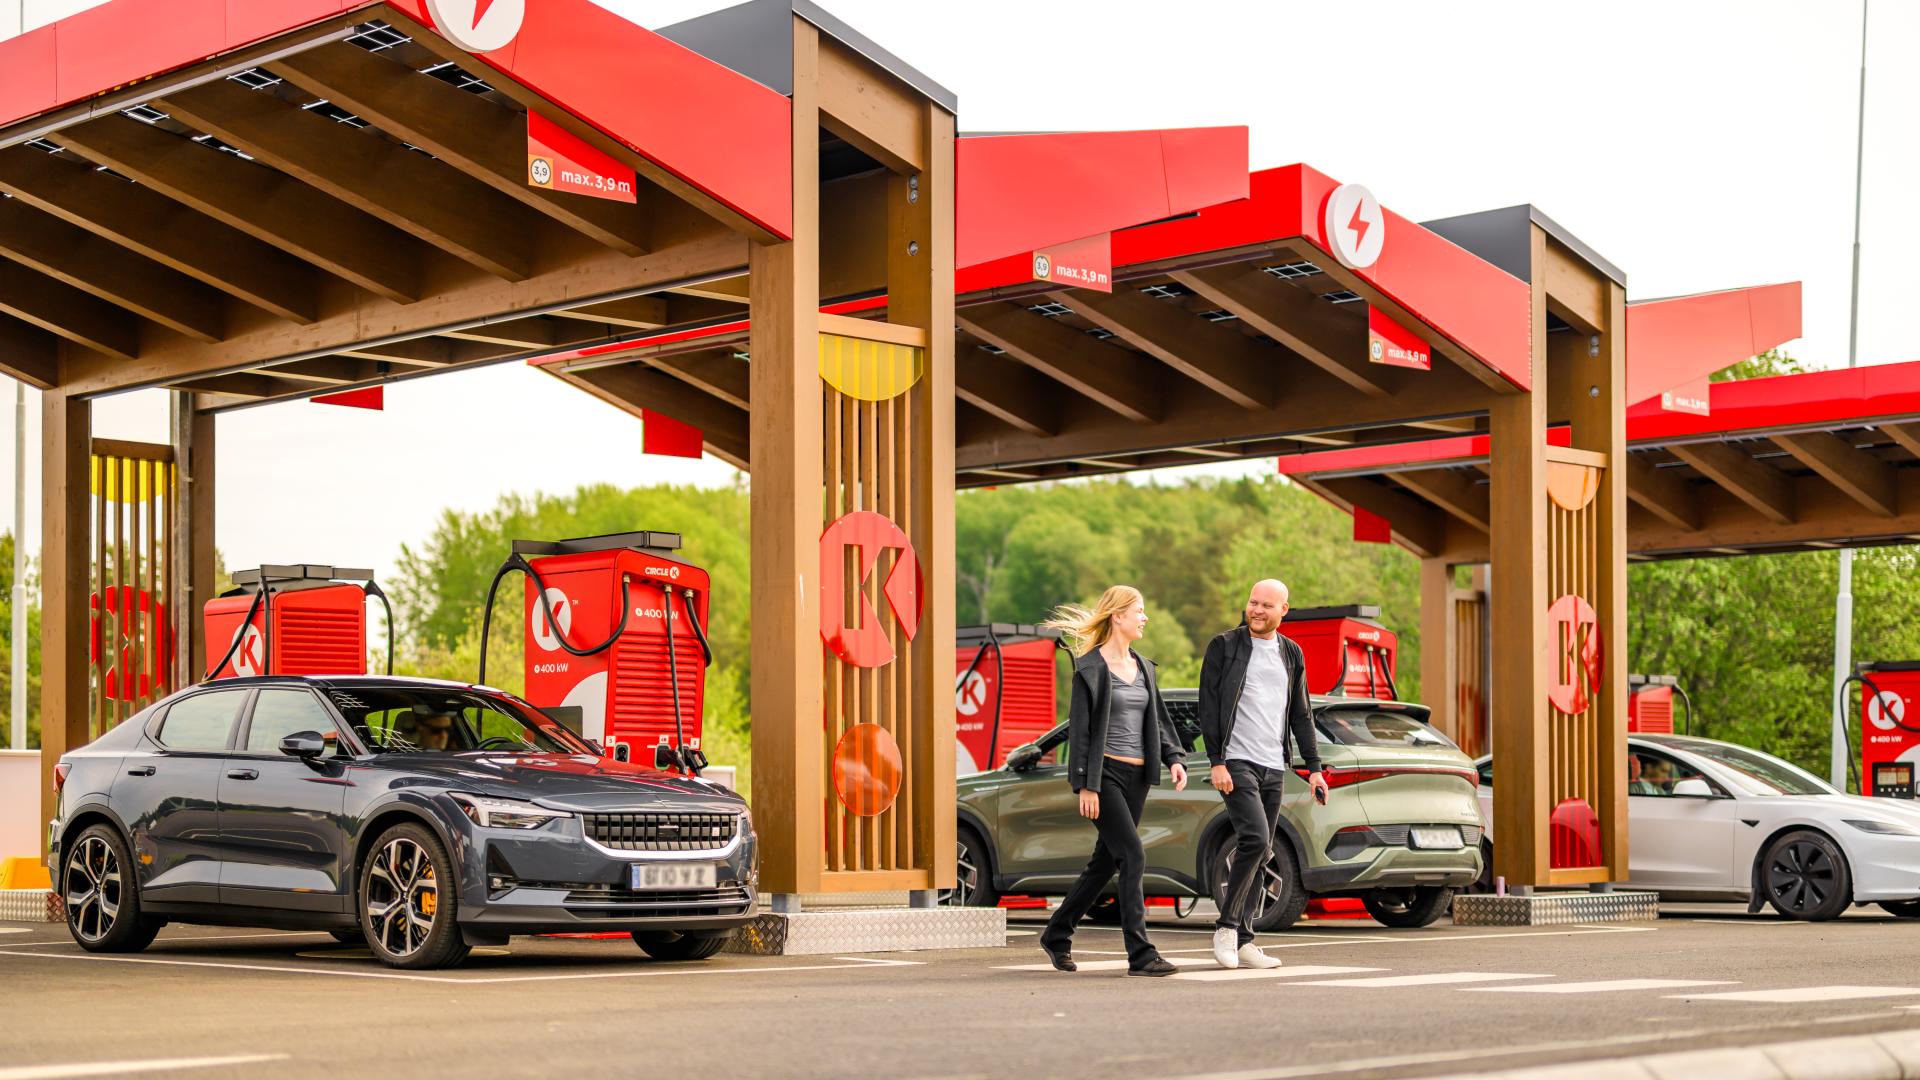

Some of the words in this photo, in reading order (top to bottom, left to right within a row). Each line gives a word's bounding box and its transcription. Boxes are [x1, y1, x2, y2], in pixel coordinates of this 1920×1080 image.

[534, 165, 548, 176] 3,9
[561, 170, 593, 186] max.
[595, 175, 616, 192] 3,9
[618, 180, 631, 193] m
[1056, 265, 1080, 279] max.
[1081, 268, 1097, 283] 3,9
[1097, 273, 1108, 284] m
[645, 566, 669, 577] CIRCLE
[671, 567, 680, 578] K
[644, 608, 662, 619] 400
[540, 663, 555, 673] 400
[556, 662, 569, 673] kW
